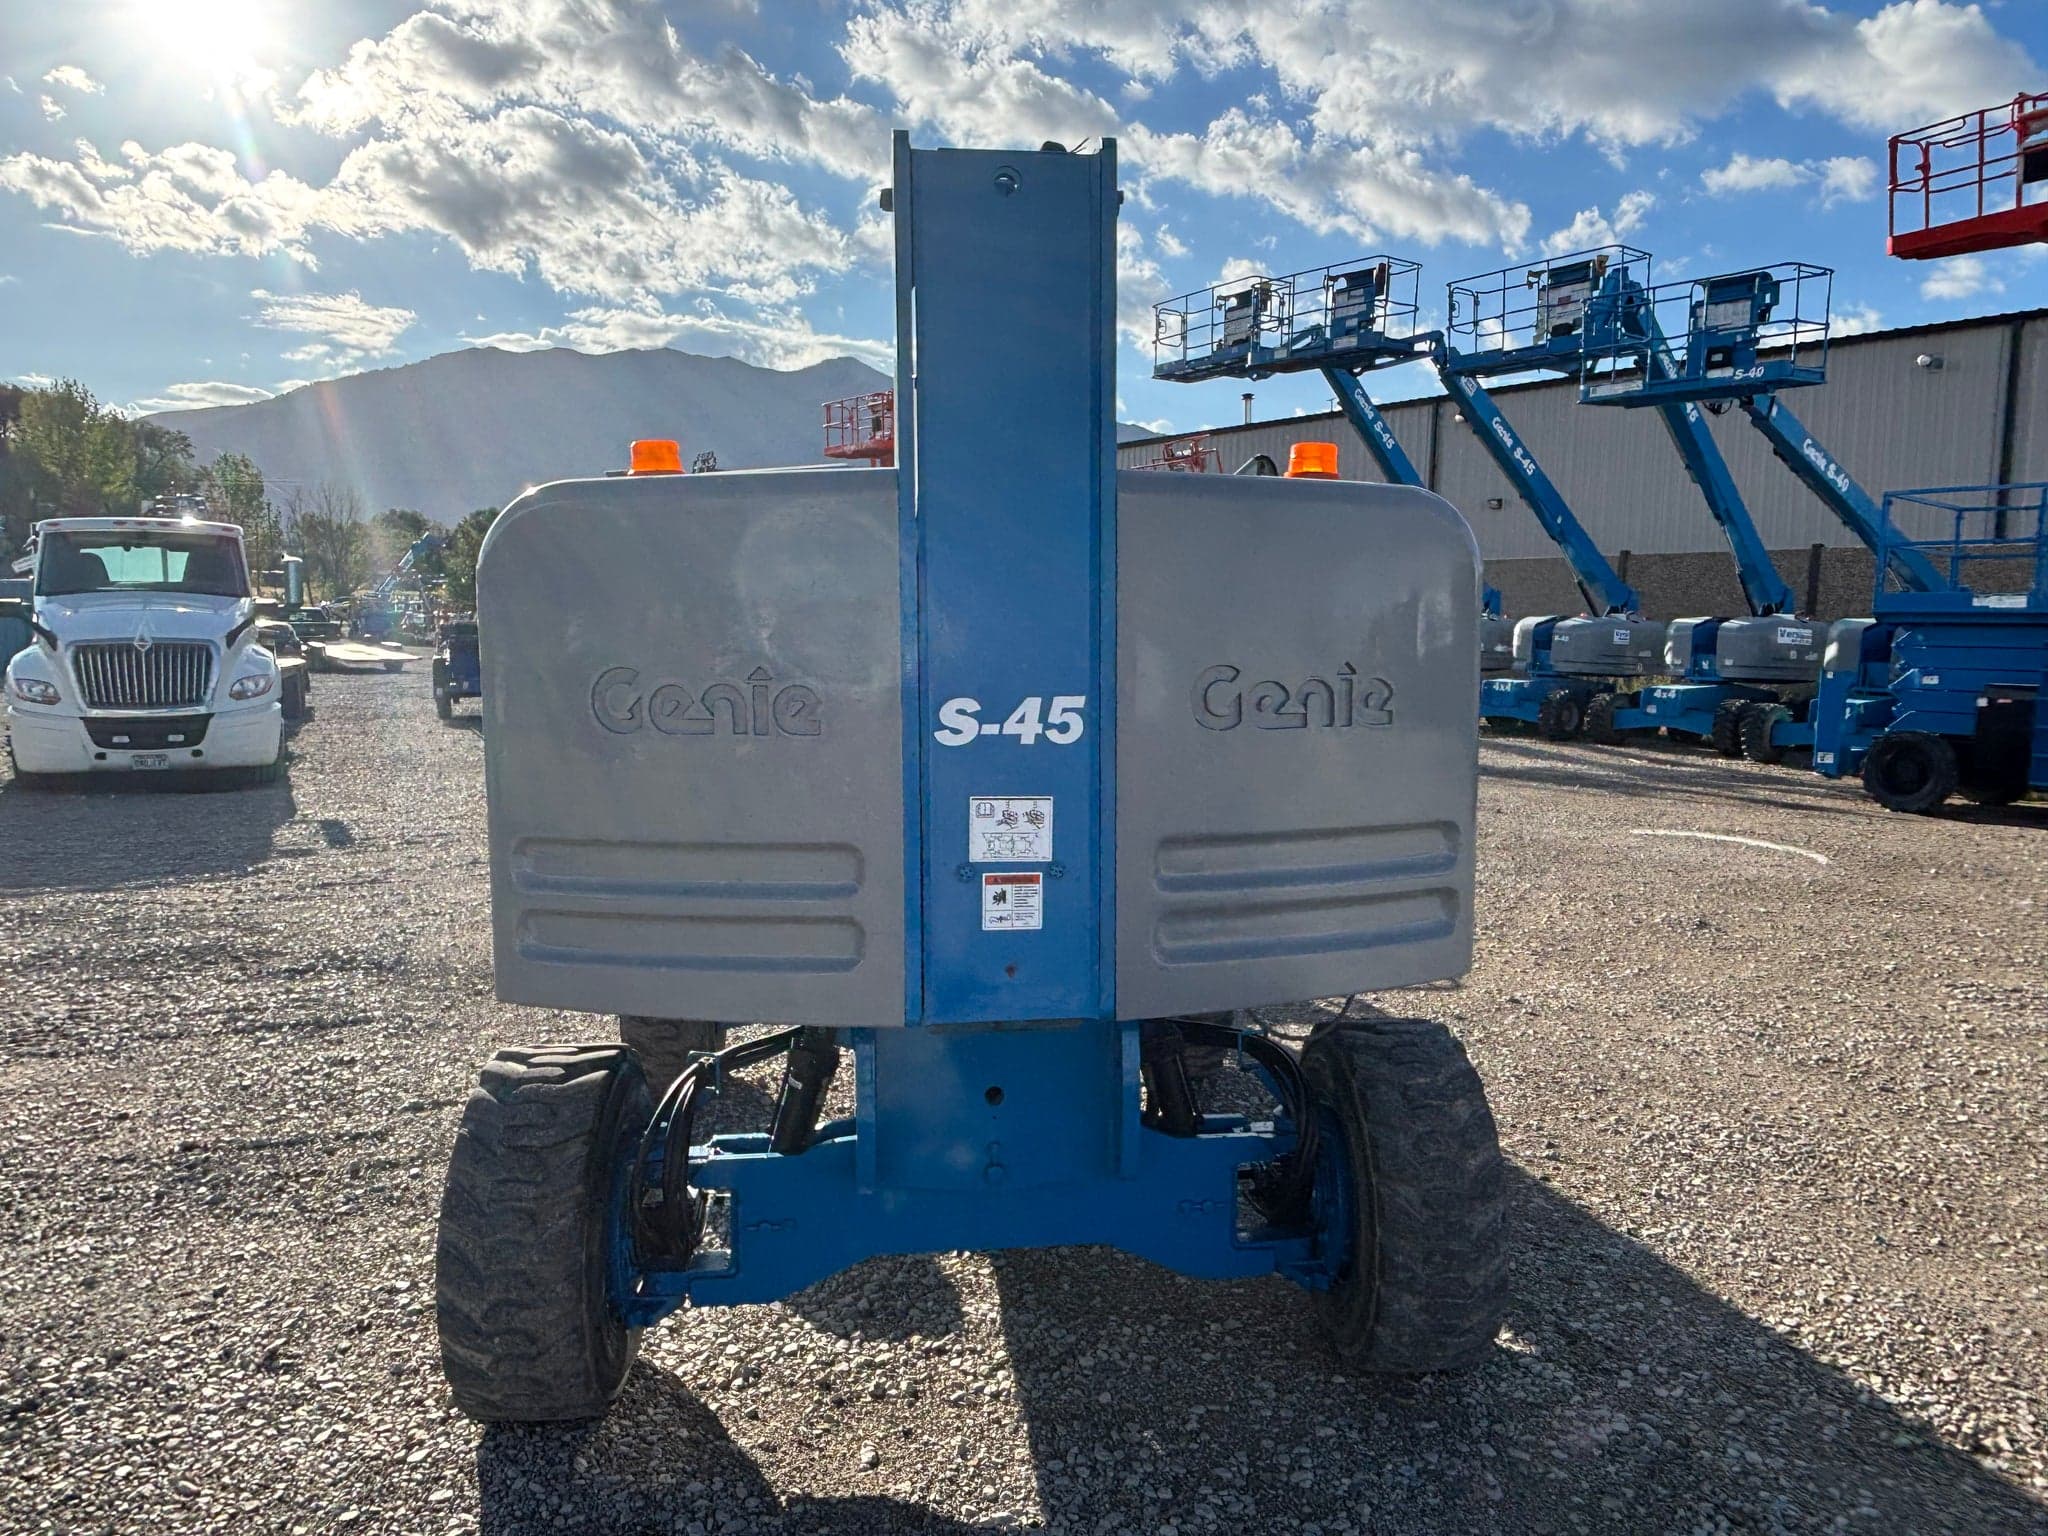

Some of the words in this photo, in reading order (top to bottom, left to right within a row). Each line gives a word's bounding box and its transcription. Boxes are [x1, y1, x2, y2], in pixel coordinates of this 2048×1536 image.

[1733, 365, 1765, 380] S-40
[1373, 421, 1396, 450] S-45
[1513, 447, 1536, 476] S-45
[591, 666, 822, 736] Genie
[1191, 661, 1395, 731] Genie
[1653, 688, 1677, 699] 4x4
[933, 695, 1087, 747] S-45
